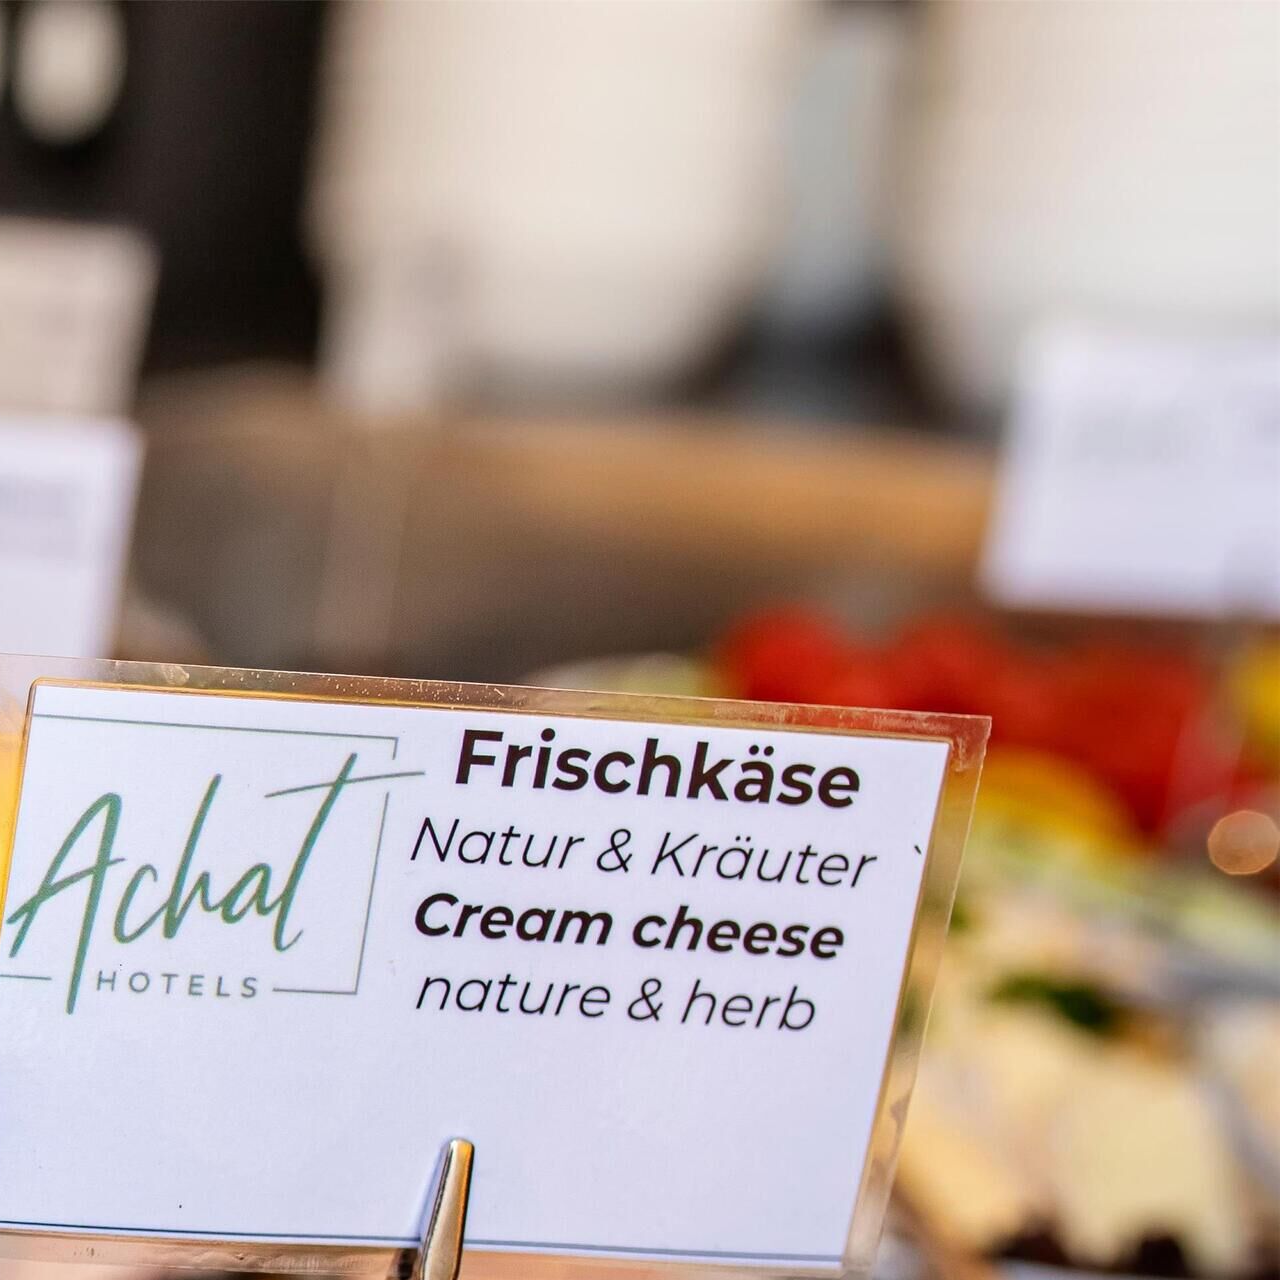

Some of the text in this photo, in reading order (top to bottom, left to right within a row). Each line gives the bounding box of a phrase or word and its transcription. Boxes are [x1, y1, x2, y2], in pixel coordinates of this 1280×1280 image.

[455, 728, 860, 809] Frischkäse
[6, 750, 426, 1016] Achat
[410, 817, 877, 888] Natur & Kräuter
[415, 893, 844, 960] Cream cheese
[97, 971, 256, 998] HOTELS
[416, 974, 815, 1031] nature & herb
